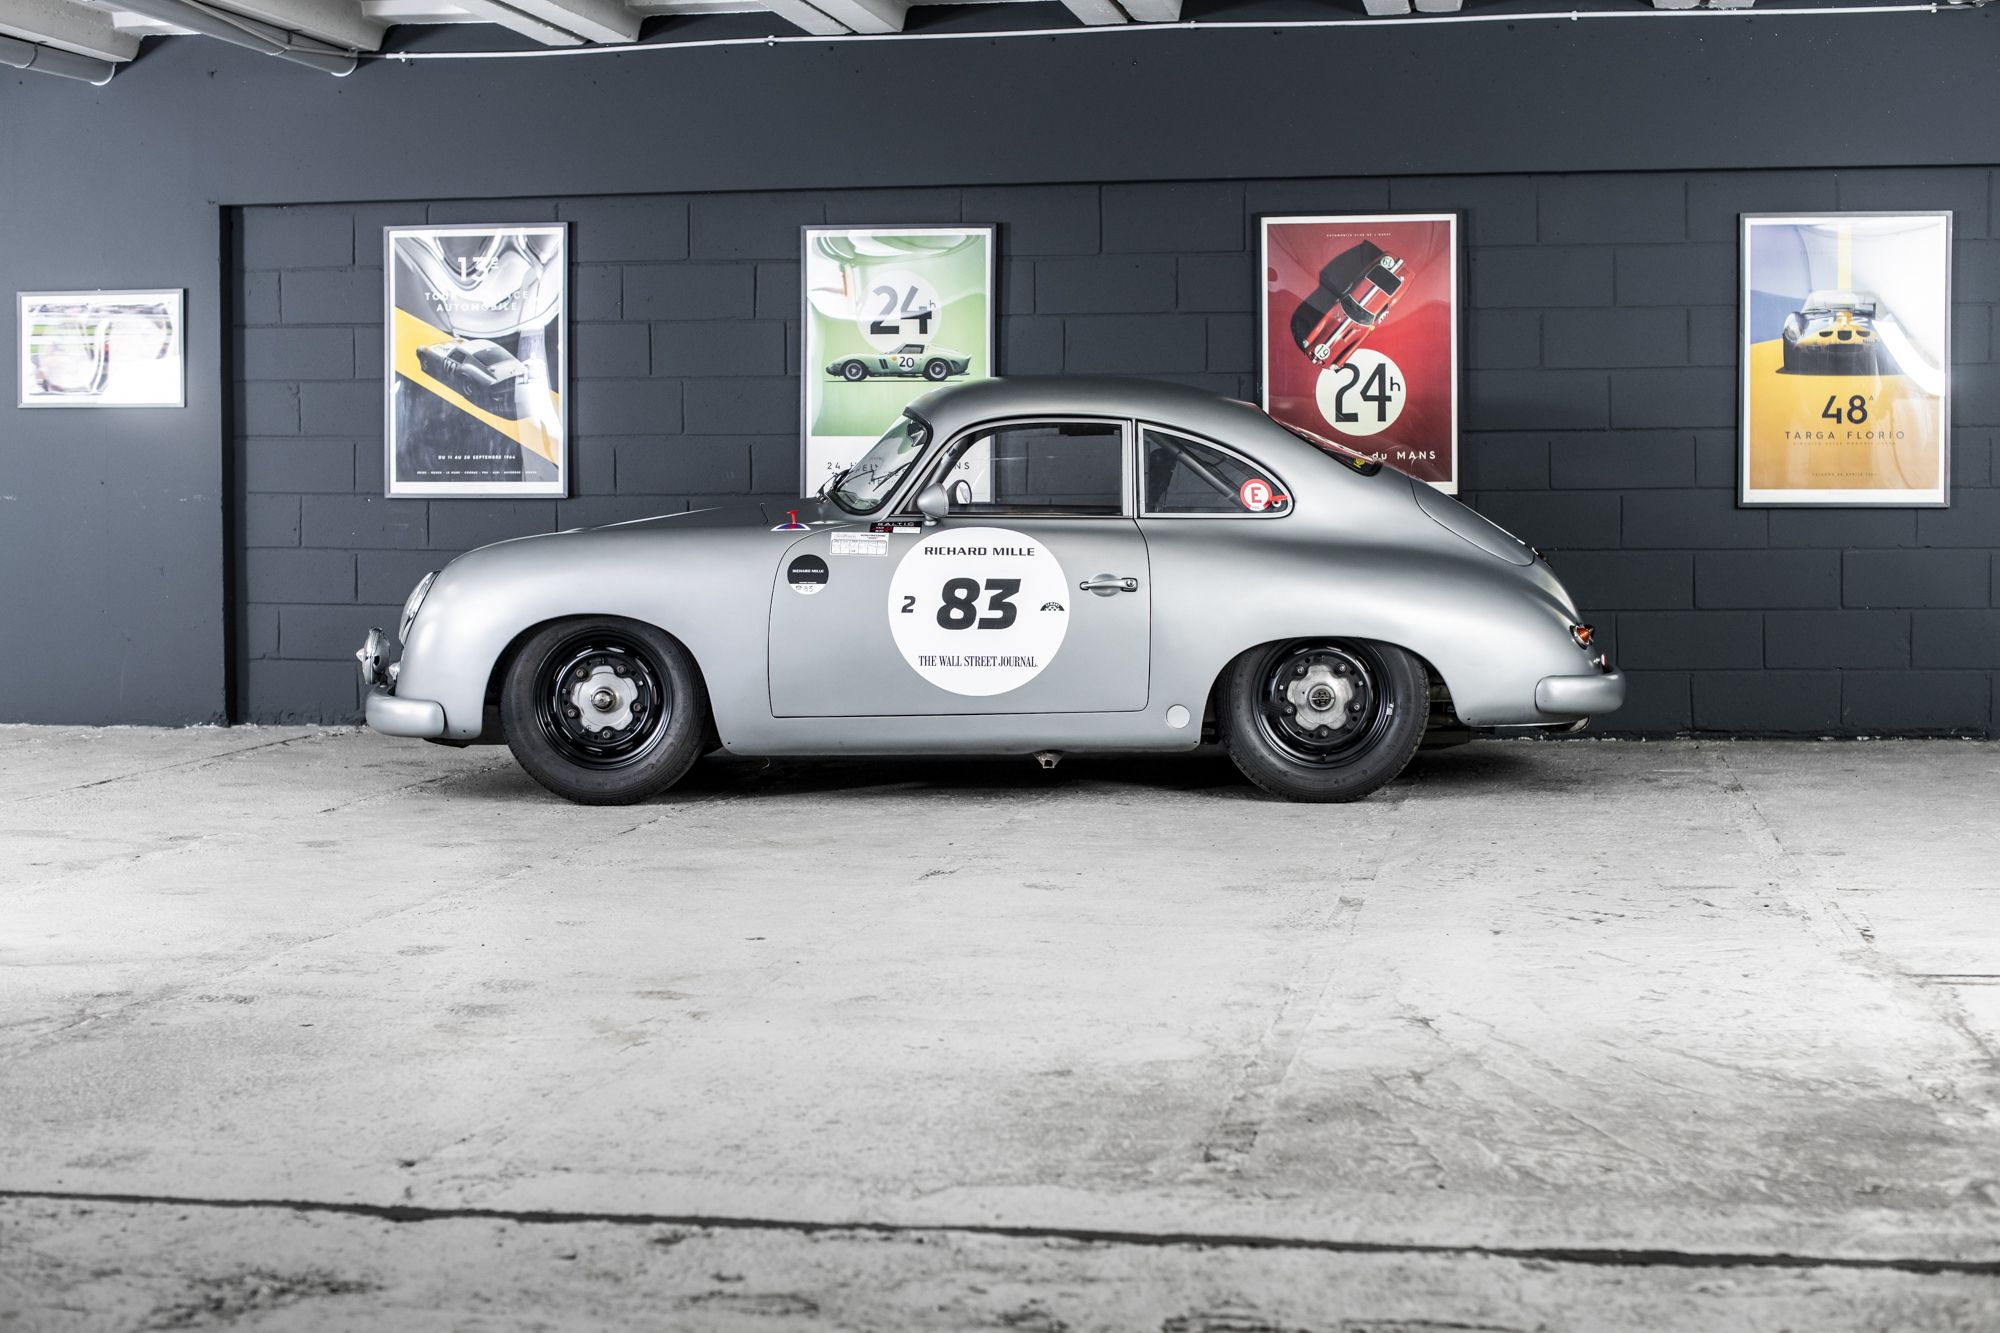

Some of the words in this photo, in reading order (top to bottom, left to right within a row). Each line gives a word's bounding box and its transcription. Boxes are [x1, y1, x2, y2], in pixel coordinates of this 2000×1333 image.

[899, 356, 915, 368] 20
[1785, 431, 1835, 439] TARGA
[1847, 430, 1905, 439] FLORIO
[1396, 450, 1436, 460] MANS
[1250, 486, 1262, 503] E
[925, 547, 988, 557] RICHARD
[993, 547, 1035, 557] MILLE
[901, 595, 917, 614] 2
[936, 577, 1022, 631] 83
[918, 655, 937, 667] THE
[938, 655, 962, 667] WALL
[964, 655, 997, 668] STREET
